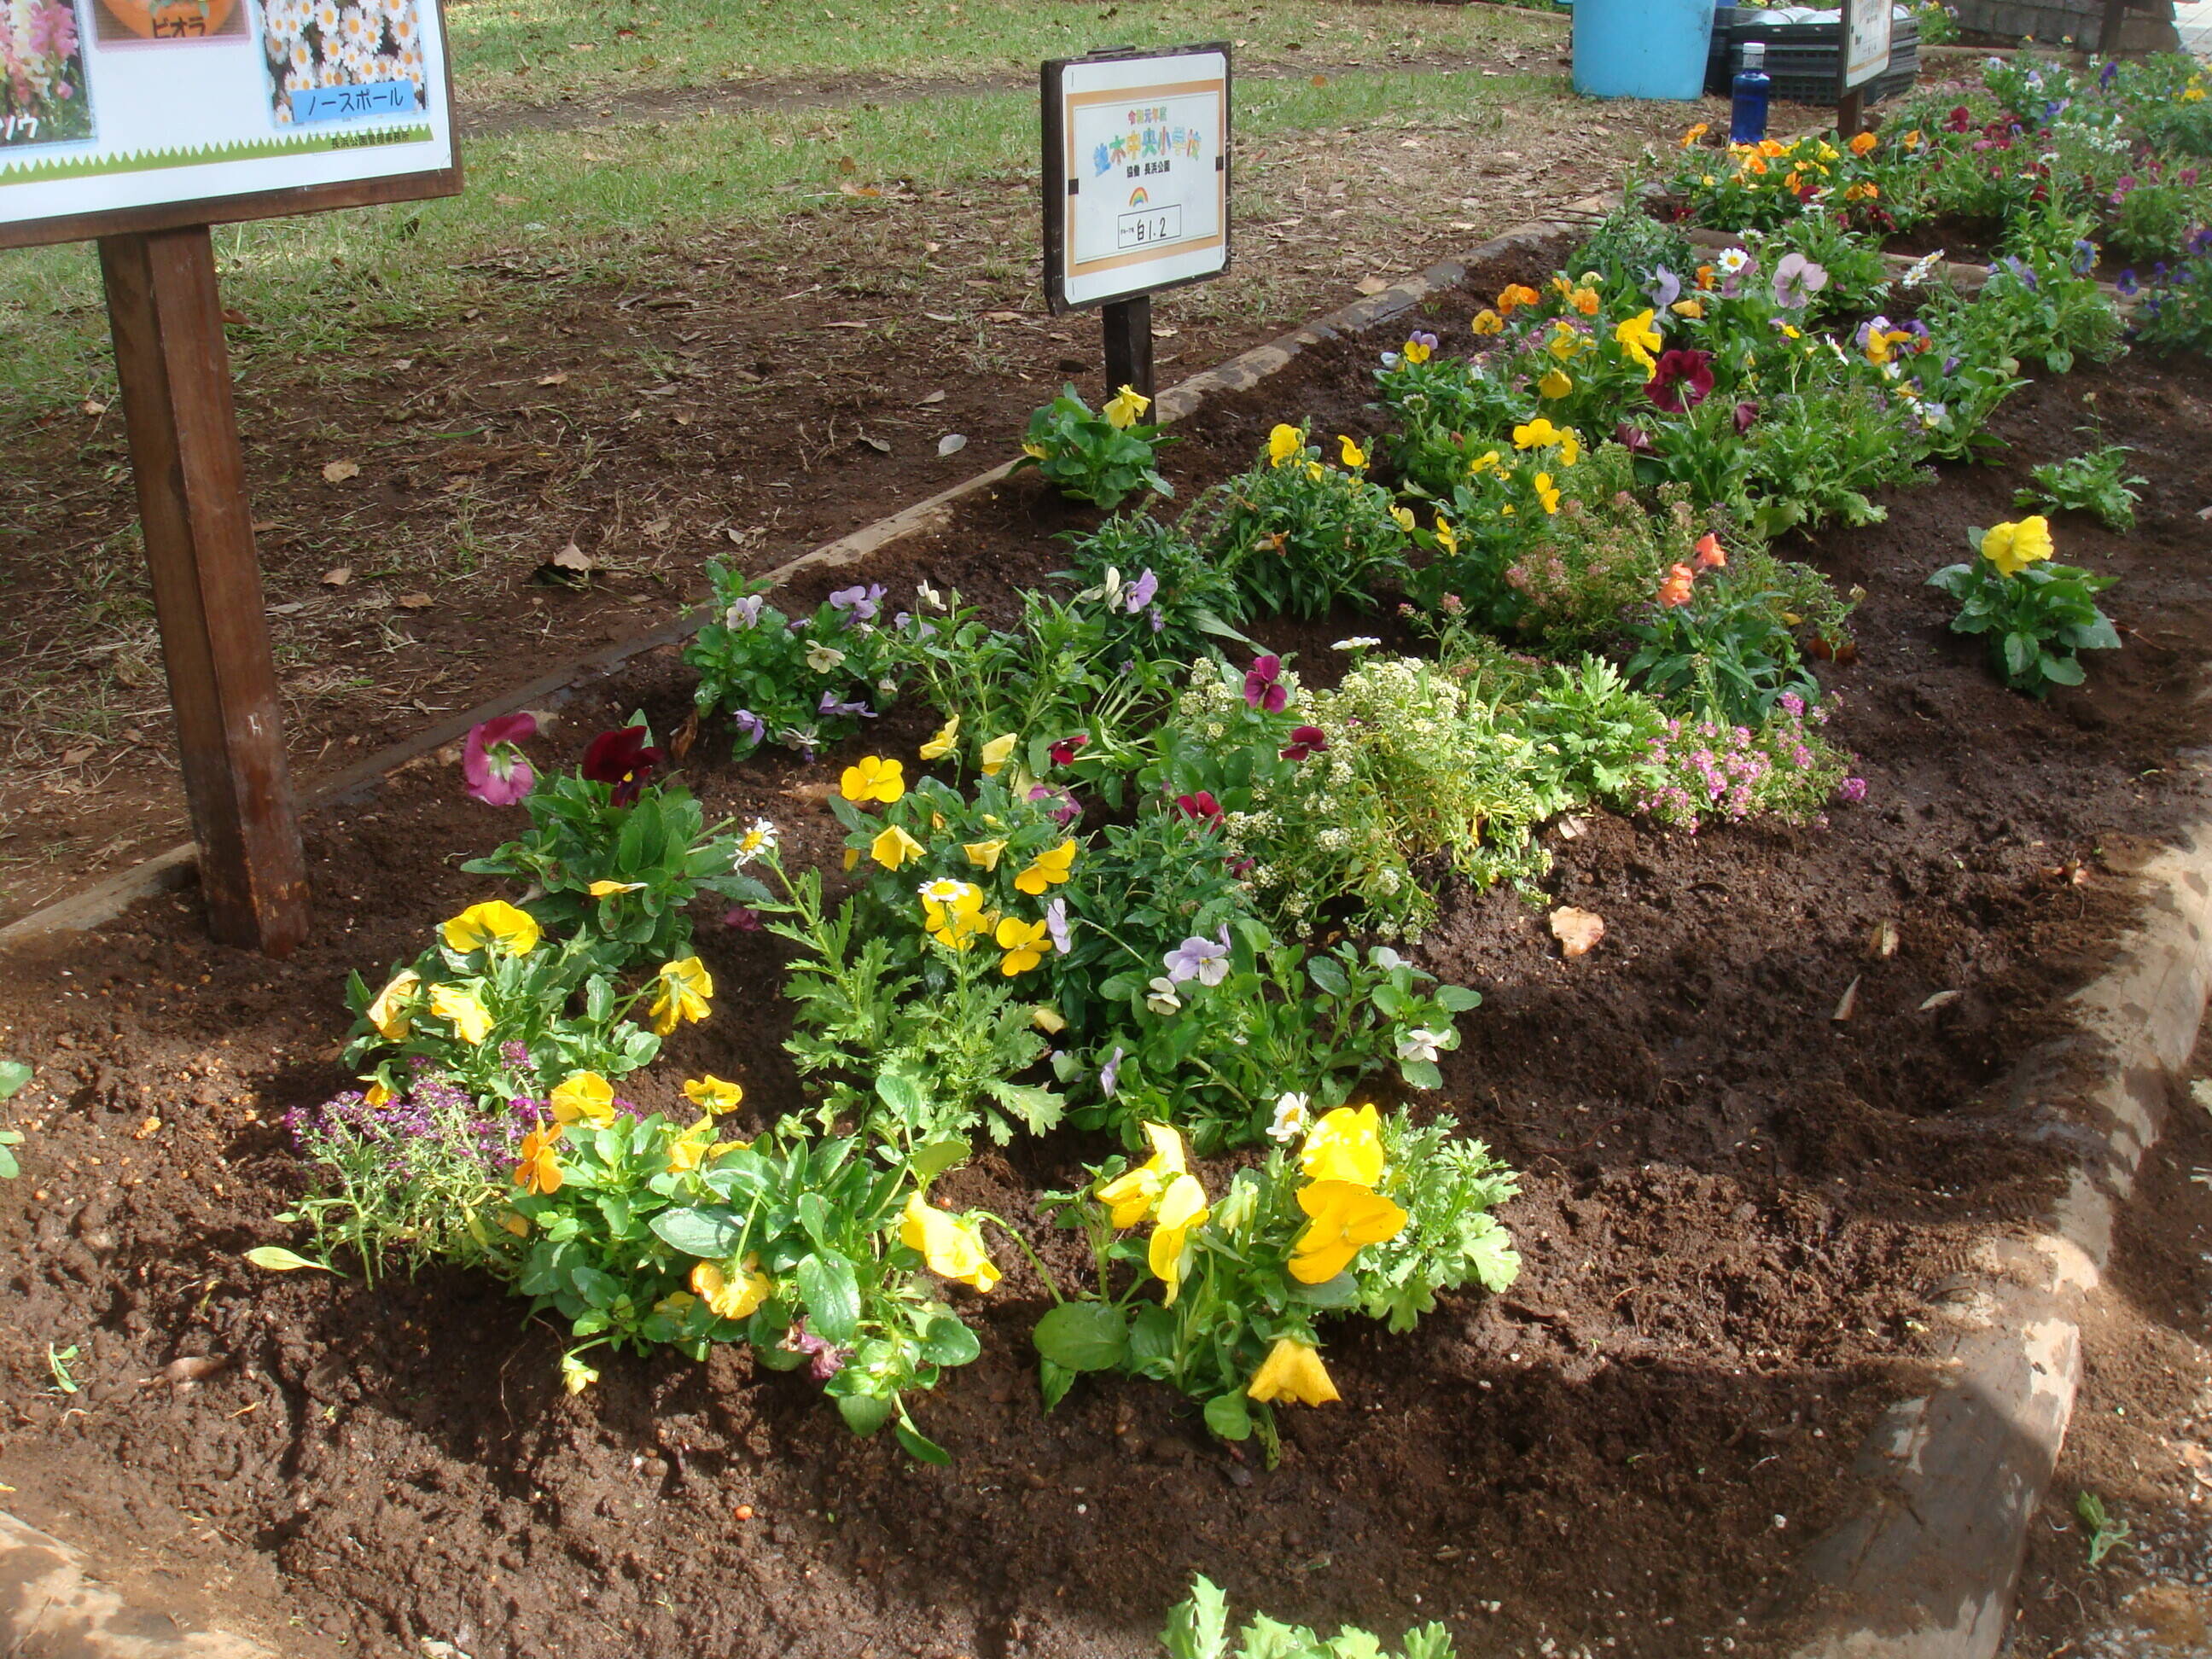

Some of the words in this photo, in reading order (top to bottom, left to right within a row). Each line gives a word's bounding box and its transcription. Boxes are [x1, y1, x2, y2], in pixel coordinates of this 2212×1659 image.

[152, 15, 206, 38] ビオラ
[309, 87, 403, 116] ノースポール
[331, 131, 410, 149] 長浜公園管理事務所
[1144, 160, 1170, 175] 長浜公園
